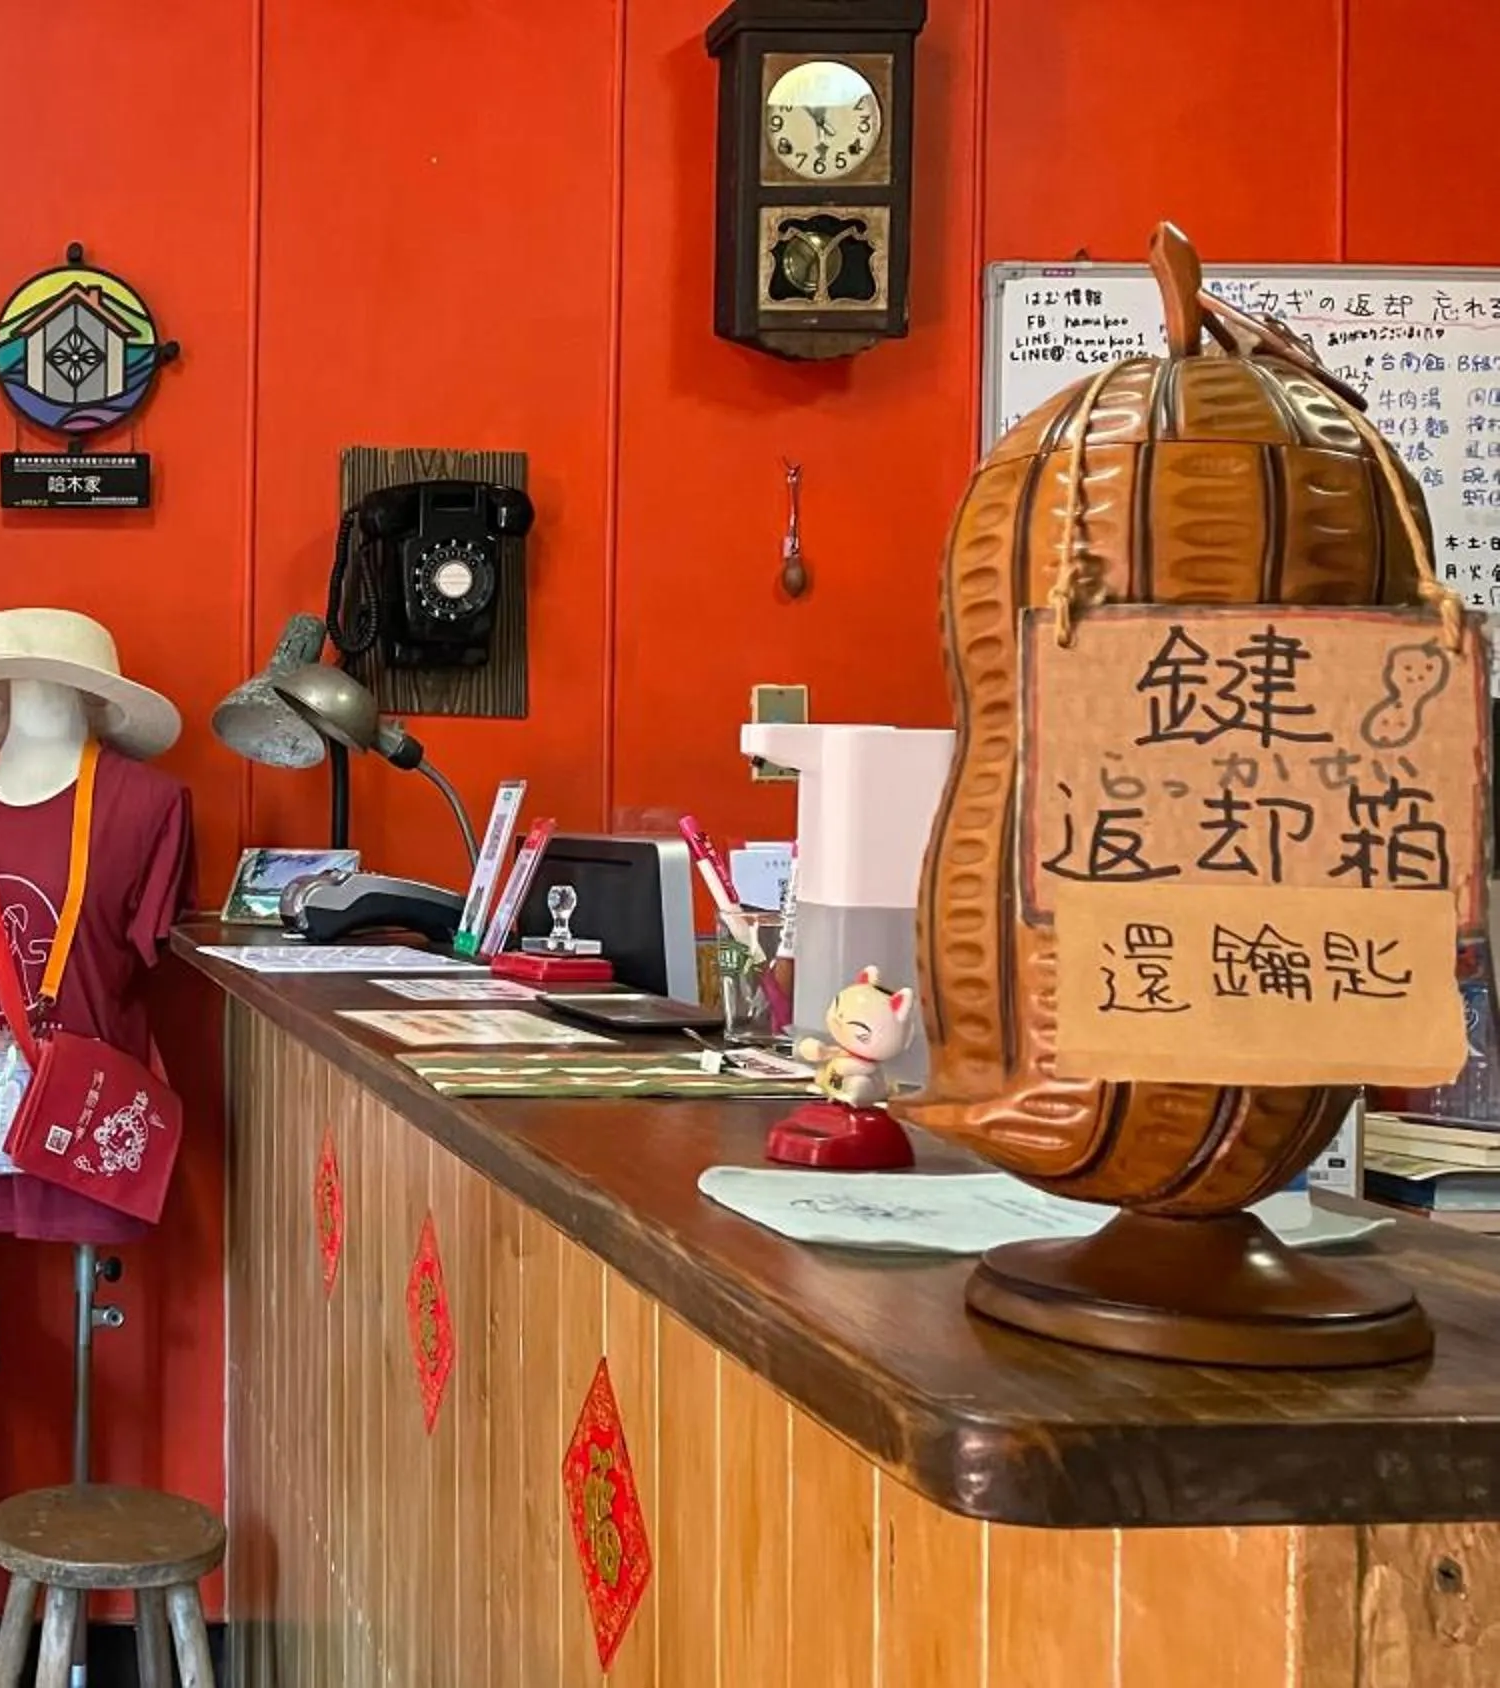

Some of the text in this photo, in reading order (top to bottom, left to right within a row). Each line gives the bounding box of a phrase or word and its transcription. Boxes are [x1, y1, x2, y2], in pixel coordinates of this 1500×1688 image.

[770, 115, 784, 133] 9
[858, 115, 871, 134] 3
[796, 152, 807, 170] 7
[813, 157, 827, 175] 6
[835, 150, 848, 170] 5
[1260, 289, 1414, 316] カギの返却
[1065, 315, 1129, 330] hamukoo
[1064, 332, 1145, 348] hamukoo1
[1135, 624, 1334, 749] 鍵
[1100, 747, 1419, 799] らっかせい
[1041, 777, 1449, 890] 返却箱
[1098, 923, 1413, 1013] 還鑰匙
